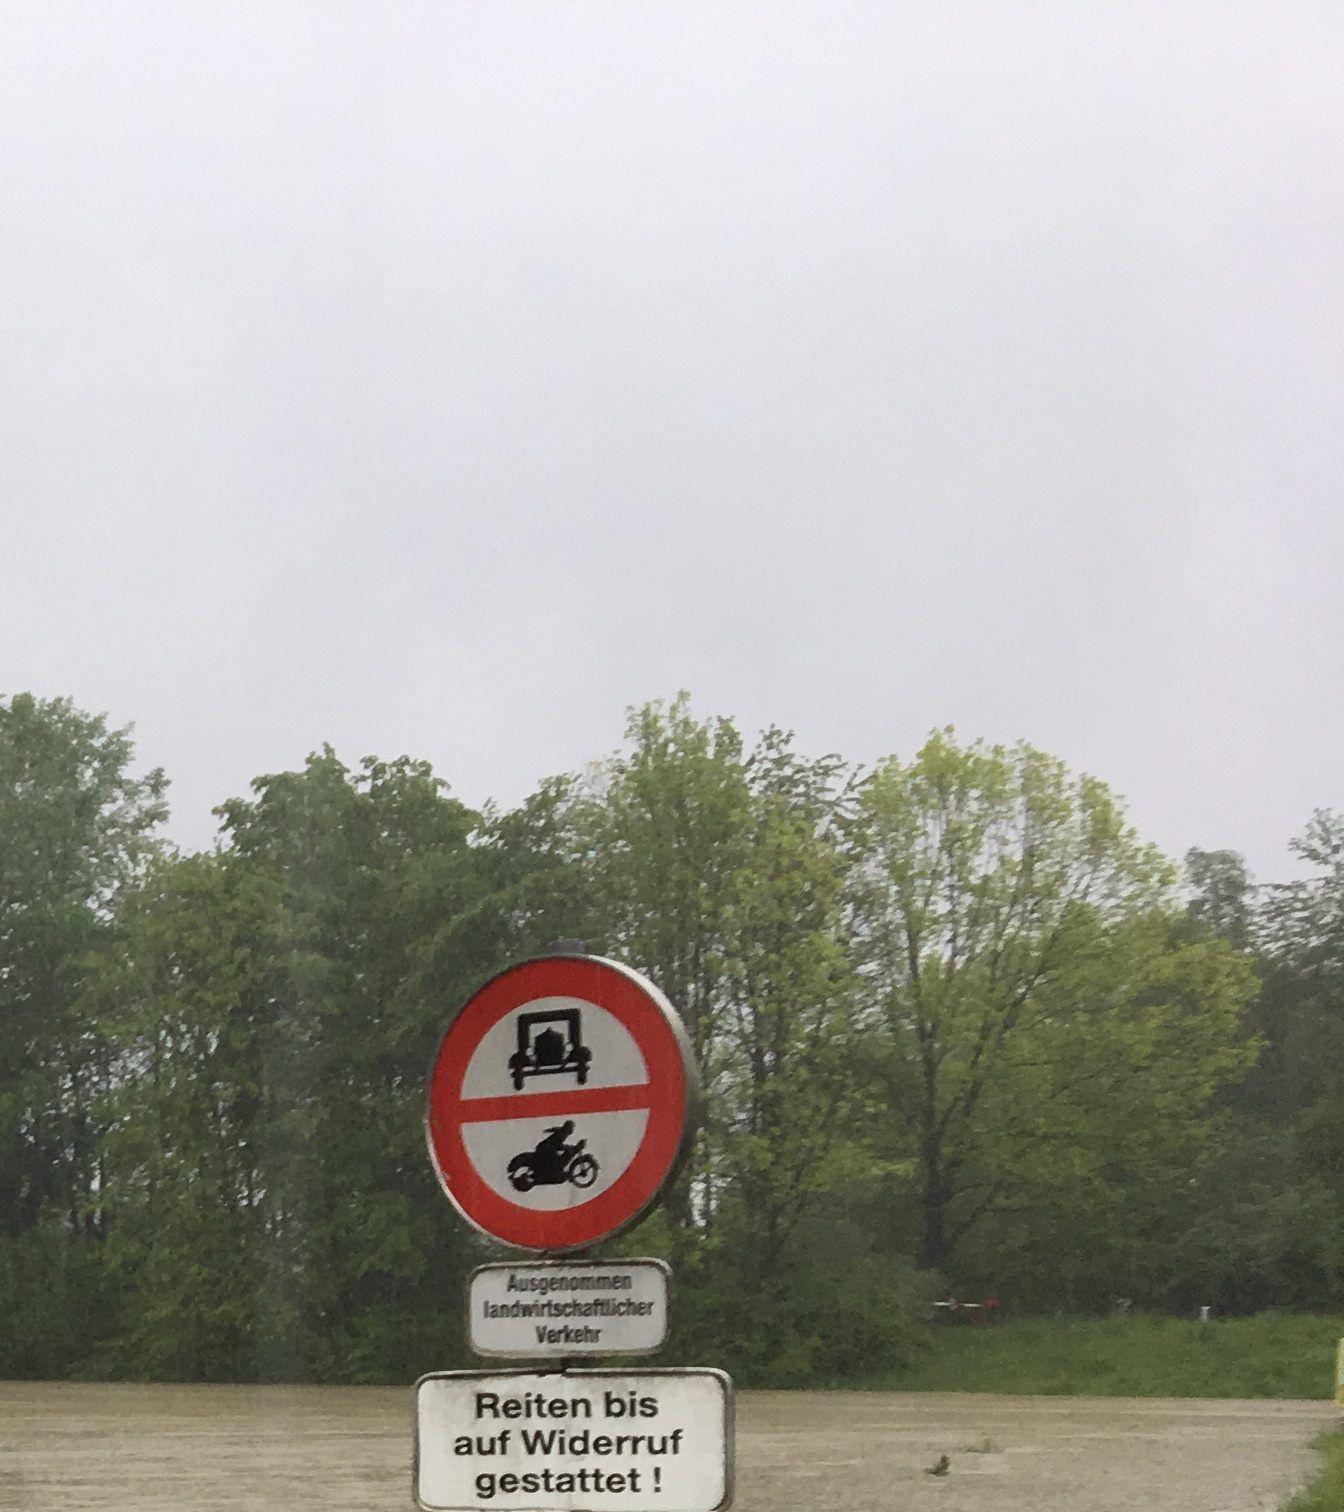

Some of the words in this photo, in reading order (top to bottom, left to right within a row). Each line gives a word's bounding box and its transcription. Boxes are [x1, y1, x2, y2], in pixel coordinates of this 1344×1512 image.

[507, 1274, 632, 1295] Ausgenommen
[483, 1299, 654, 1318] landwirtschaftlicher
[535, 1325, 602, 1344] Verkehr
[475, 1393, 592, 1419] Reiten
[604, 1391, 659, 1418] bis
[454, 1430, 511, 1456] auf
[521, 1429, 683, 1455] Widerruf
[475, 1468, 641, 1499] gestattet
